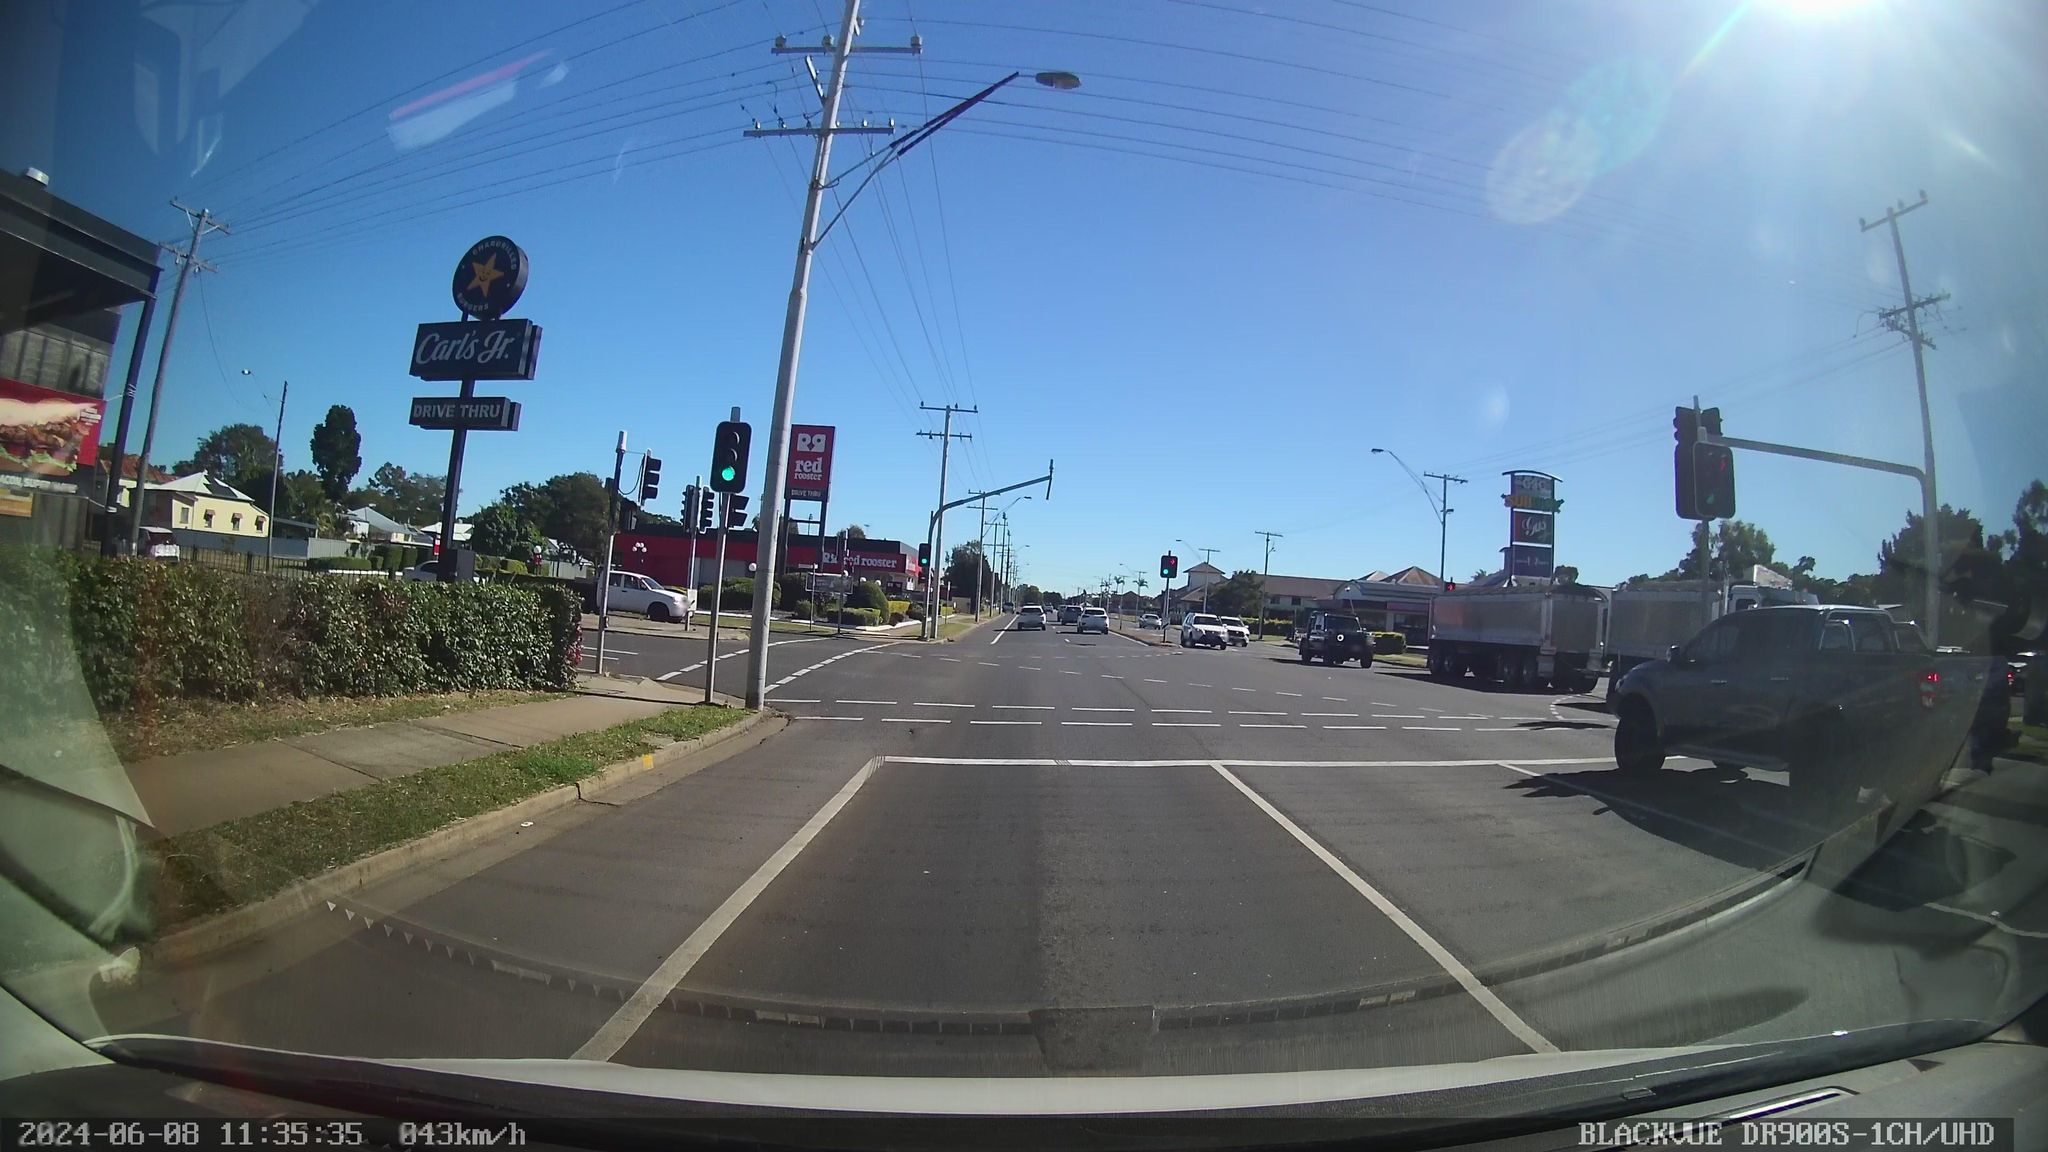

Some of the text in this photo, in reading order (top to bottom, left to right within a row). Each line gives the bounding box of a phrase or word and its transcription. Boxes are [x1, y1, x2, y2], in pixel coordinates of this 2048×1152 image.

[416, 330, 515, 365] Carl's Jr.
[413, 404, 501, 418] DRIVE THRU
[794, 457, 823, 473] red
[794, 472, 823, 481] rooster
[861, 557, 897, 568] rooster
